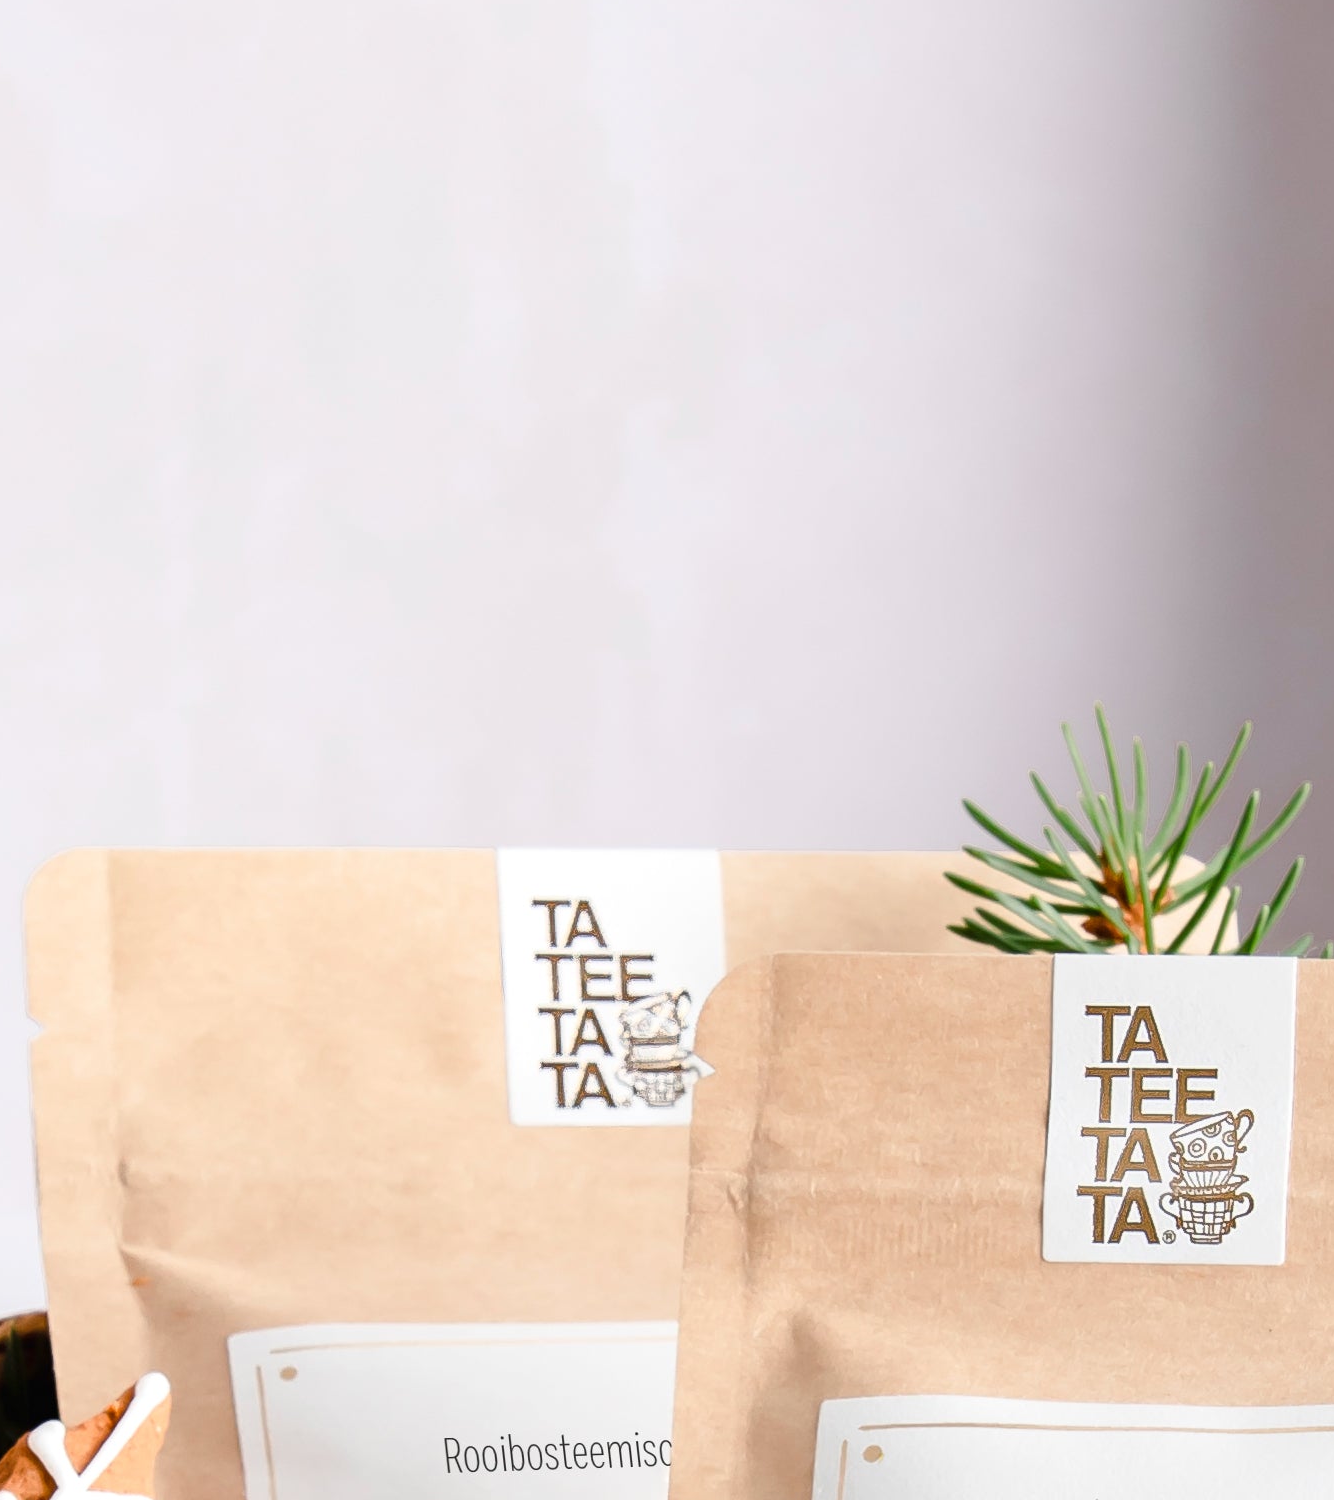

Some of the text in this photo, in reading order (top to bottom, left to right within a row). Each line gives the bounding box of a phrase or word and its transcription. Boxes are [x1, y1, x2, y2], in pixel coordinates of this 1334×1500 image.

[532, 900, 608, 948] TA
[535, 954, 655, 1003] TEE
[537, 1008, 613, 1056] TA
[1085, 1005, 1169, 1063] TA
[1085, 1066, 1218, 1124] TEE
[1080, 1127, 1163, 1182] TA
